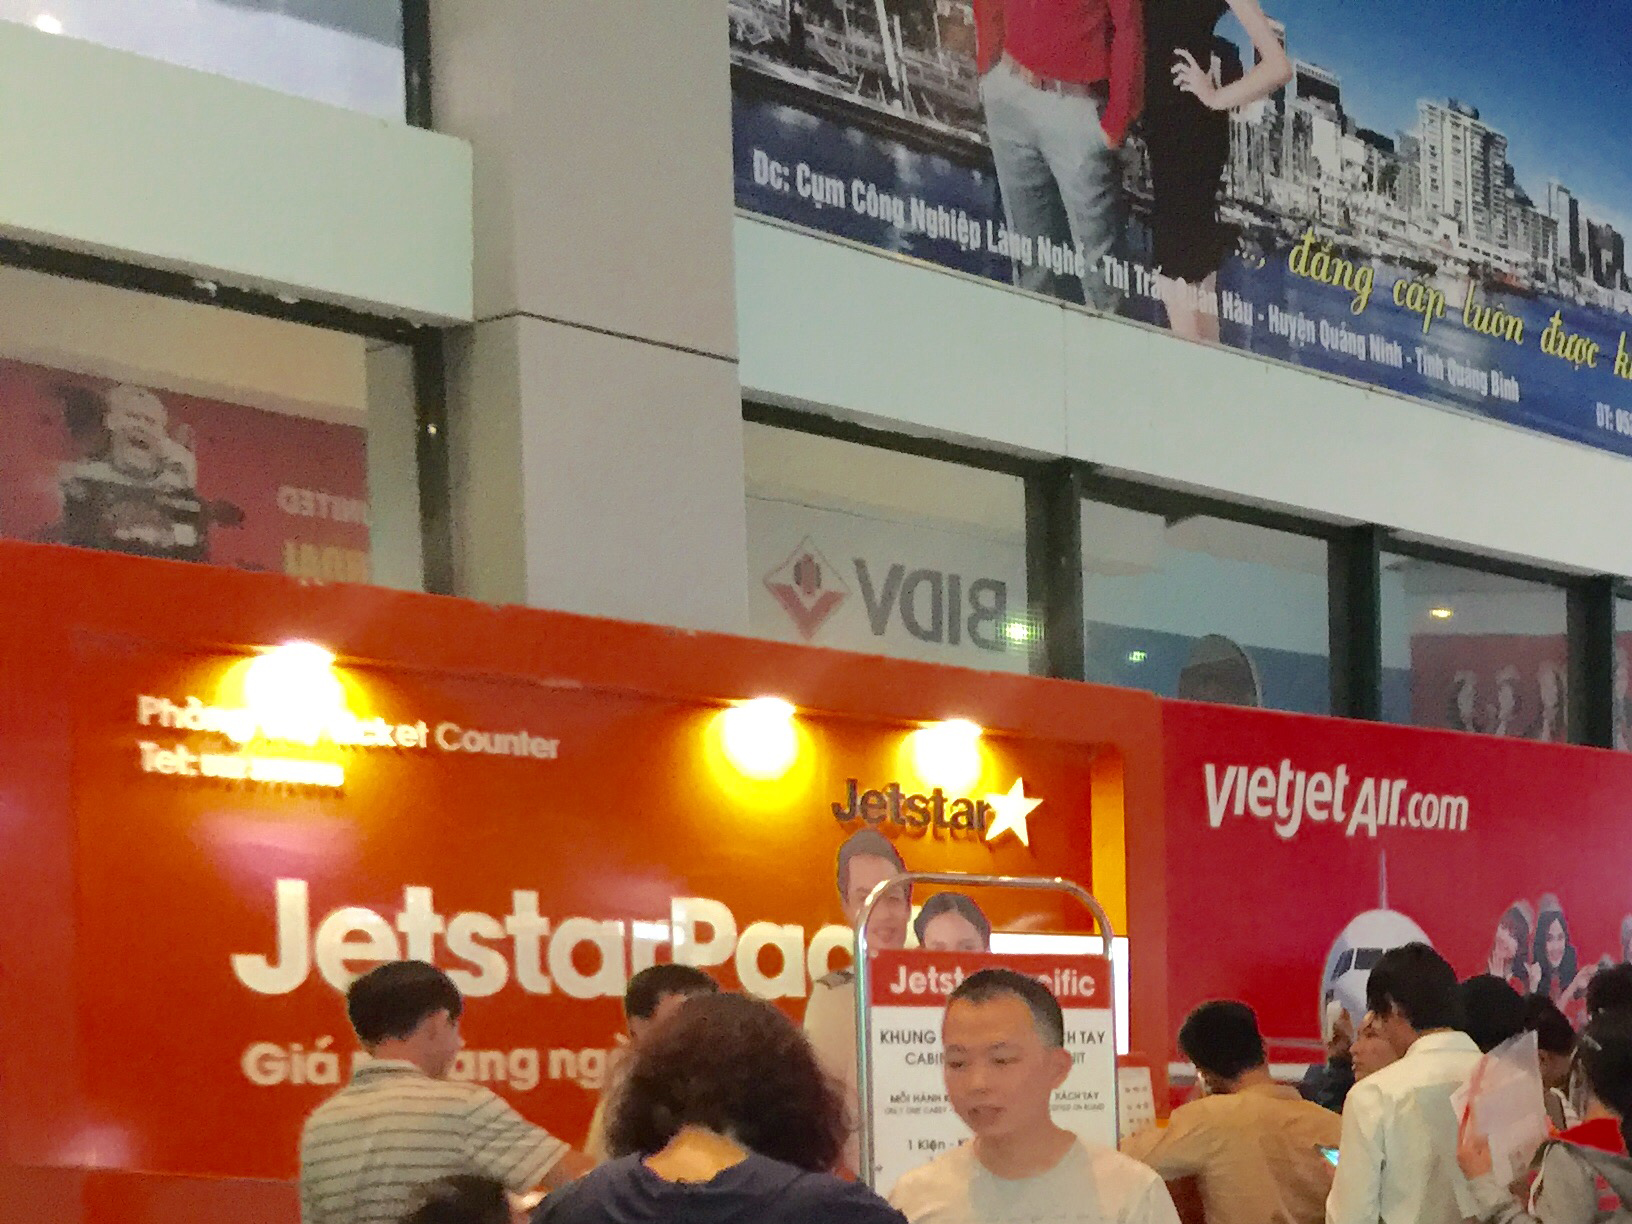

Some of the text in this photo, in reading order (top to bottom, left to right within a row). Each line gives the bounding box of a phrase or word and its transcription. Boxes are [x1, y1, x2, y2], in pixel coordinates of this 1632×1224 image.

[797, 162, 846, 209] Cụm
[851, 178, 904, 228] Công
[911, 196, 981, 251] Nghiệp
[435, 721, 560, 760] Counter
[831, 778, 992, 832] Jetstar
[232, 879, 900, 999] JetstarPac
[890, 965, 1096, 997] Jetstific
[241, 1034, 341, 1086] Giá
[880, 1030, 937, 1045] KHUNG
[1081, 1030, 1106, 1045] TAY
